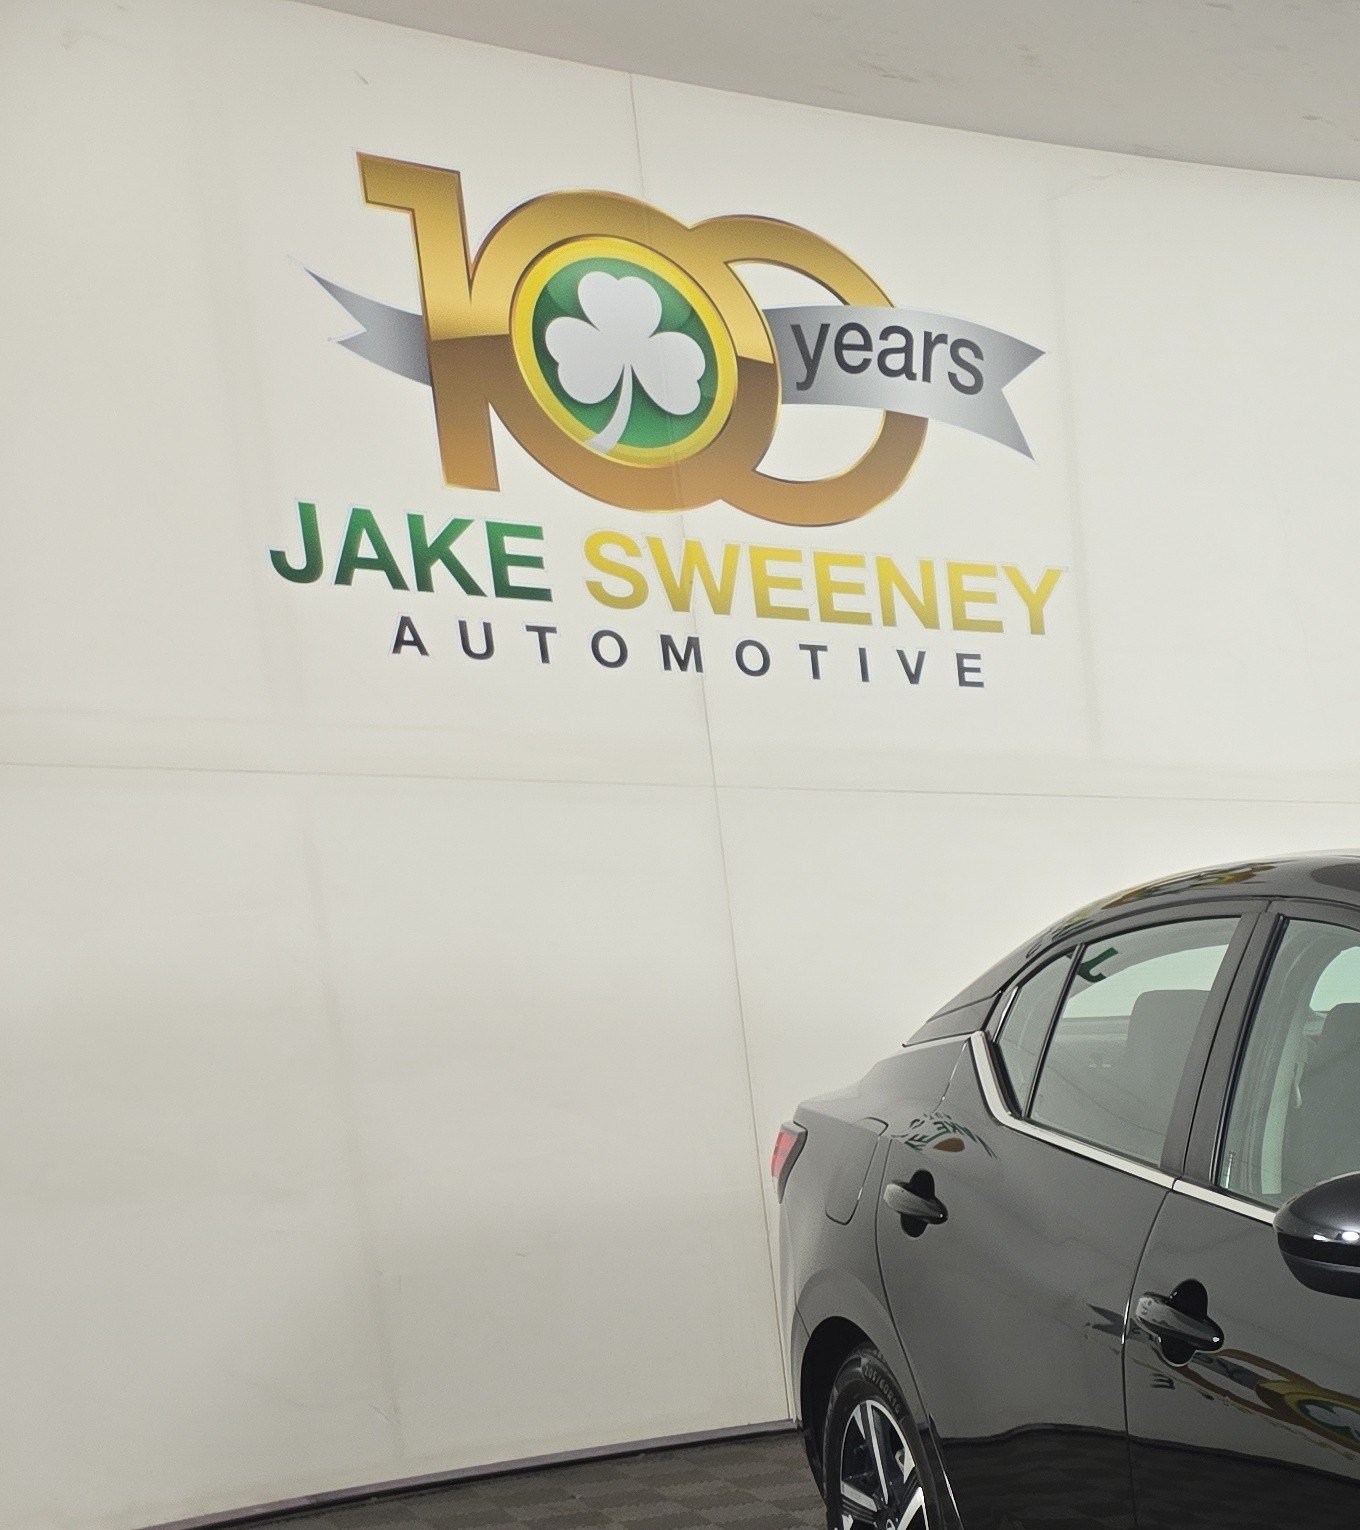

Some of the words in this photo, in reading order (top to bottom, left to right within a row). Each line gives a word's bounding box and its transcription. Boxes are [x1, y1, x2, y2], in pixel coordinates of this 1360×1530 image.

[356, 151, 929, 528] 100
[789, 322, 986, 395] years
[268, 502, 552, 603] JAKE
[582, 531, 1064, 637] SWEENEY
[391, 615, 986, 689] AUTOMOTIVE
